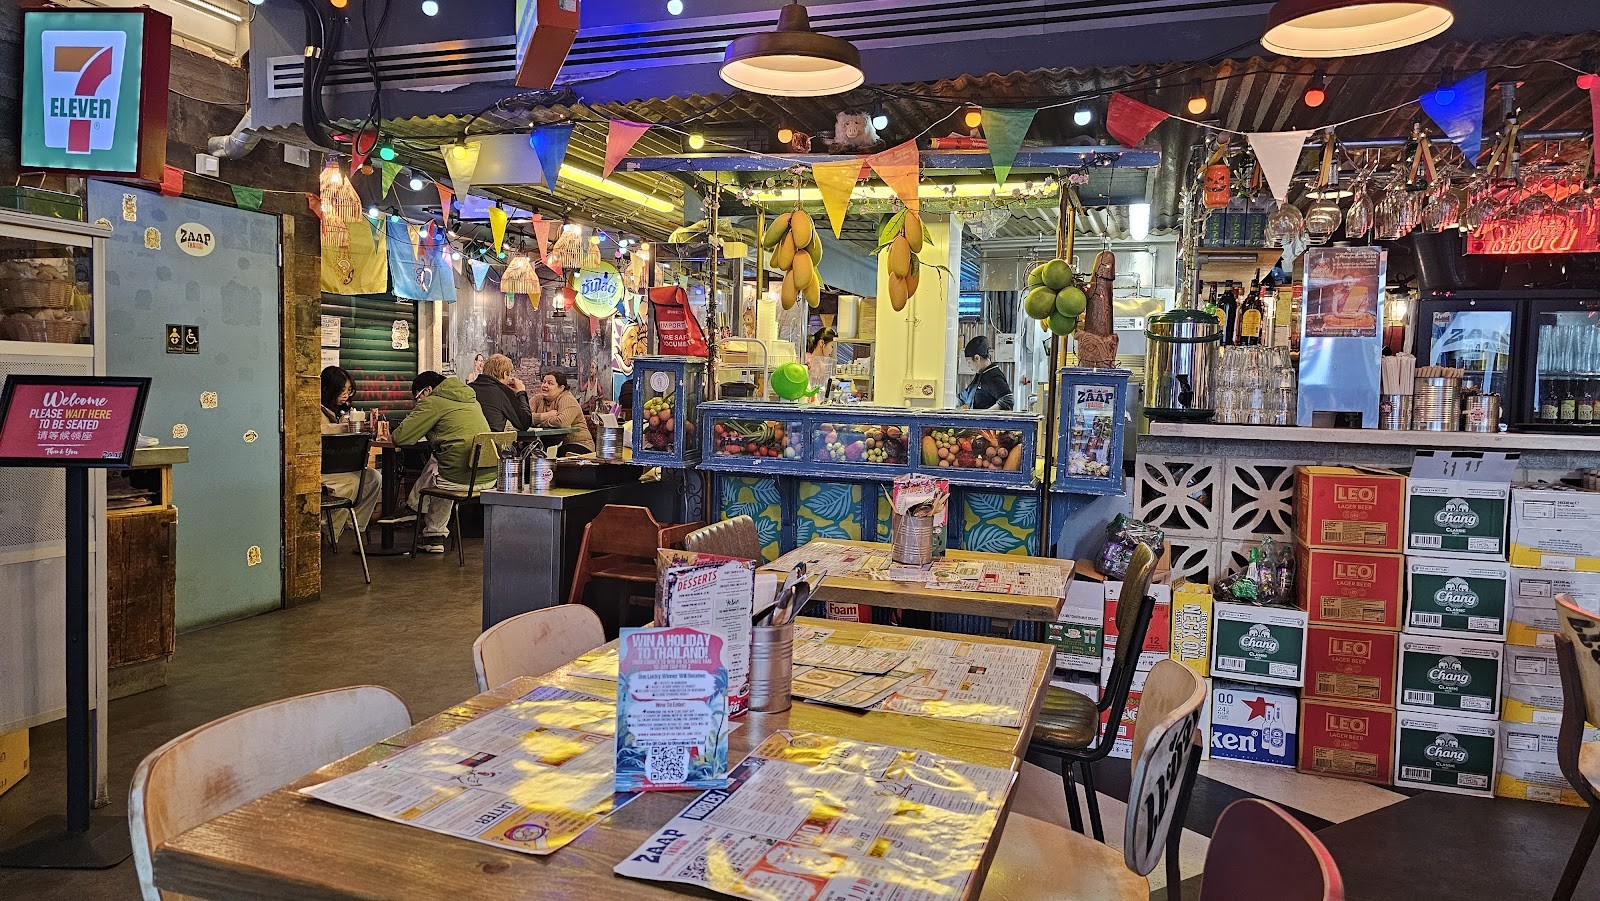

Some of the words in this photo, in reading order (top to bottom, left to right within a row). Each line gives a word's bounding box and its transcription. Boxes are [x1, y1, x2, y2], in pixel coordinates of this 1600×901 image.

[180, 228, 211, 246] ZAAP
[43, 390, 108, 407] Welcome
[1077, 390, 1114, 404] ZAAP
[29, 408, 63, 419] PLEASE
[65, 409, 87, 419] WAIT
[88, 409, 112, 420] HERE
[39, 419, 49, 429] TO
[52, 420, 64, 430] BE
[65, 420, 99, 430] SEATED
[37, 431, 93, 441] 请等候领座
[45, 447, 64, 456] Thank
[65, 448, 78, 456] You
[1337, 487, 1375, 502] LEO
[1436, 511, 1477, 526] Chang
[1336, 563, 1374, 579] LEO
[677, 570, 717, 592] DESSERTS
[1437, 592, 1477, 606] Chang
[829, 603, 857, 615] Foam
[1182, 604, 1202, 639] NECK
[632, 634, 656, 647] WIN
[656, 634, 665, 647] A
[666, 634, 711, 647] HOLIDAY
[1149, 636, 1160, 645] 12
[1240, 636, 1277, 651] Chang
[1332, 640, 1368, 656] LEO
[637, 647, 651, 660] TO
[654, 646, 709, 659] THAILAND!
[1181, 641, 1200, 661] OIL
[1331, 656, 1350, 664] LAGER
[1350, 657, 1367, 665] BEER
[1429, 668, 1469, 684] Chang
[1218, 692, 1234, 704] 0.0
[1329, 715, 1366, 732] LEO
[1328, 732, 1348, 740] LAGER
[1425, 744, 1466, 761] Chang
[631, 829, 686, 864] ZAAP
